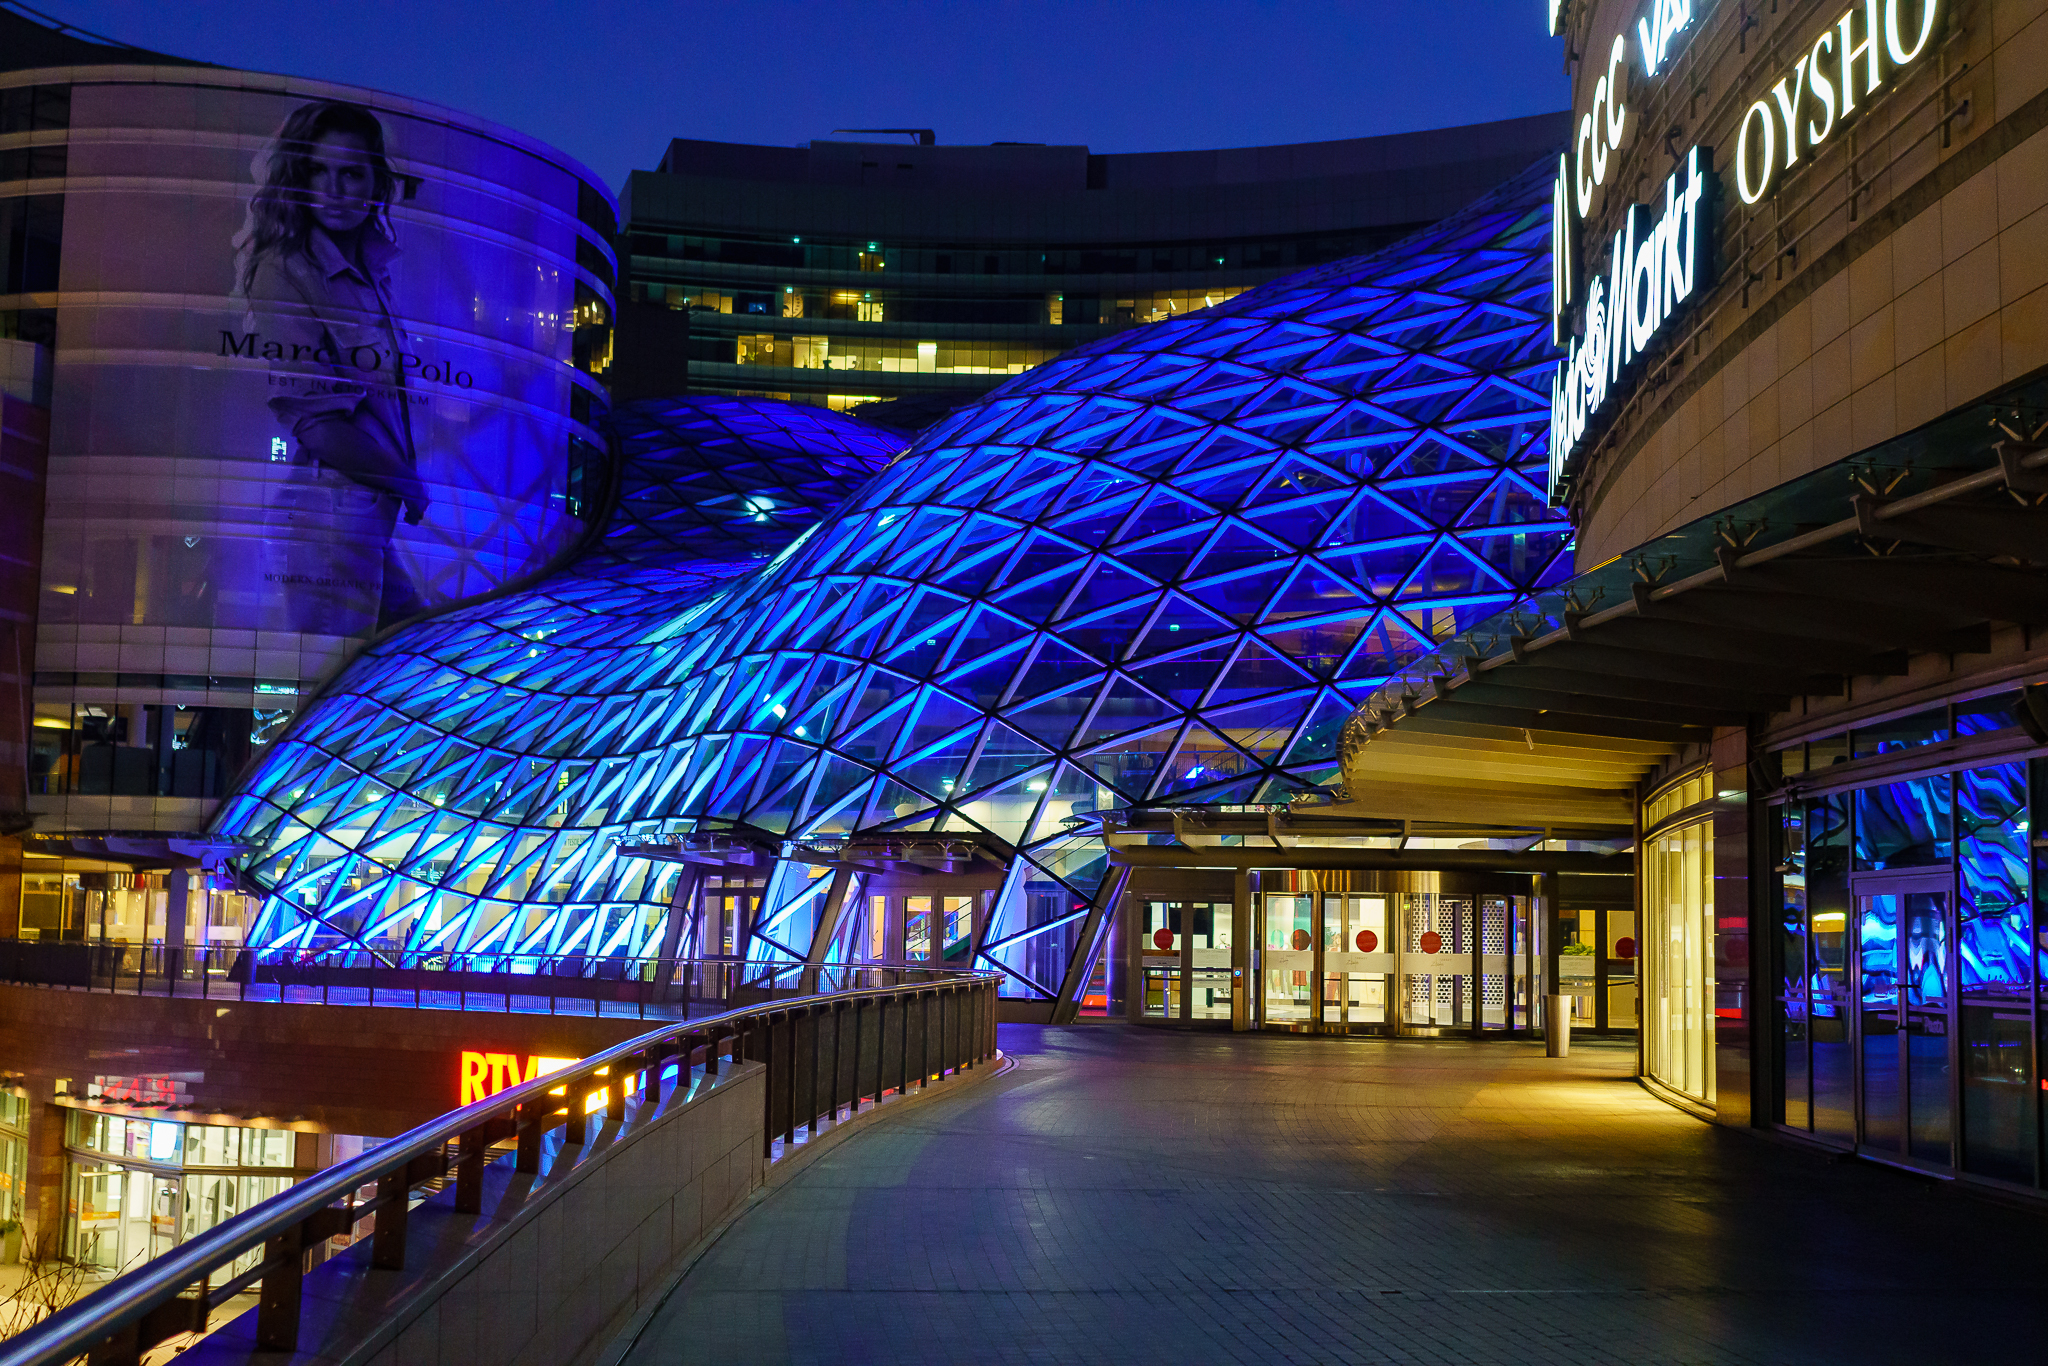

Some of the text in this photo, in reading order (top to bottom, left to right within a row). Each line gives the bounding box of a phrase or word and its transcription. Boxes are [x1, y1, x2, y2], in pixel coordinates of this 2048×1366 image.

[1736, 0, 1937, 204] OYSHO
[1576, 33, 1625, 219] CCC
[218, 330, 333, 366] Marc
[311, 379, 327, 391] IN
[264, 573, 312, 585] MODERN
[316, 576, 366, 590] ORGANIC
